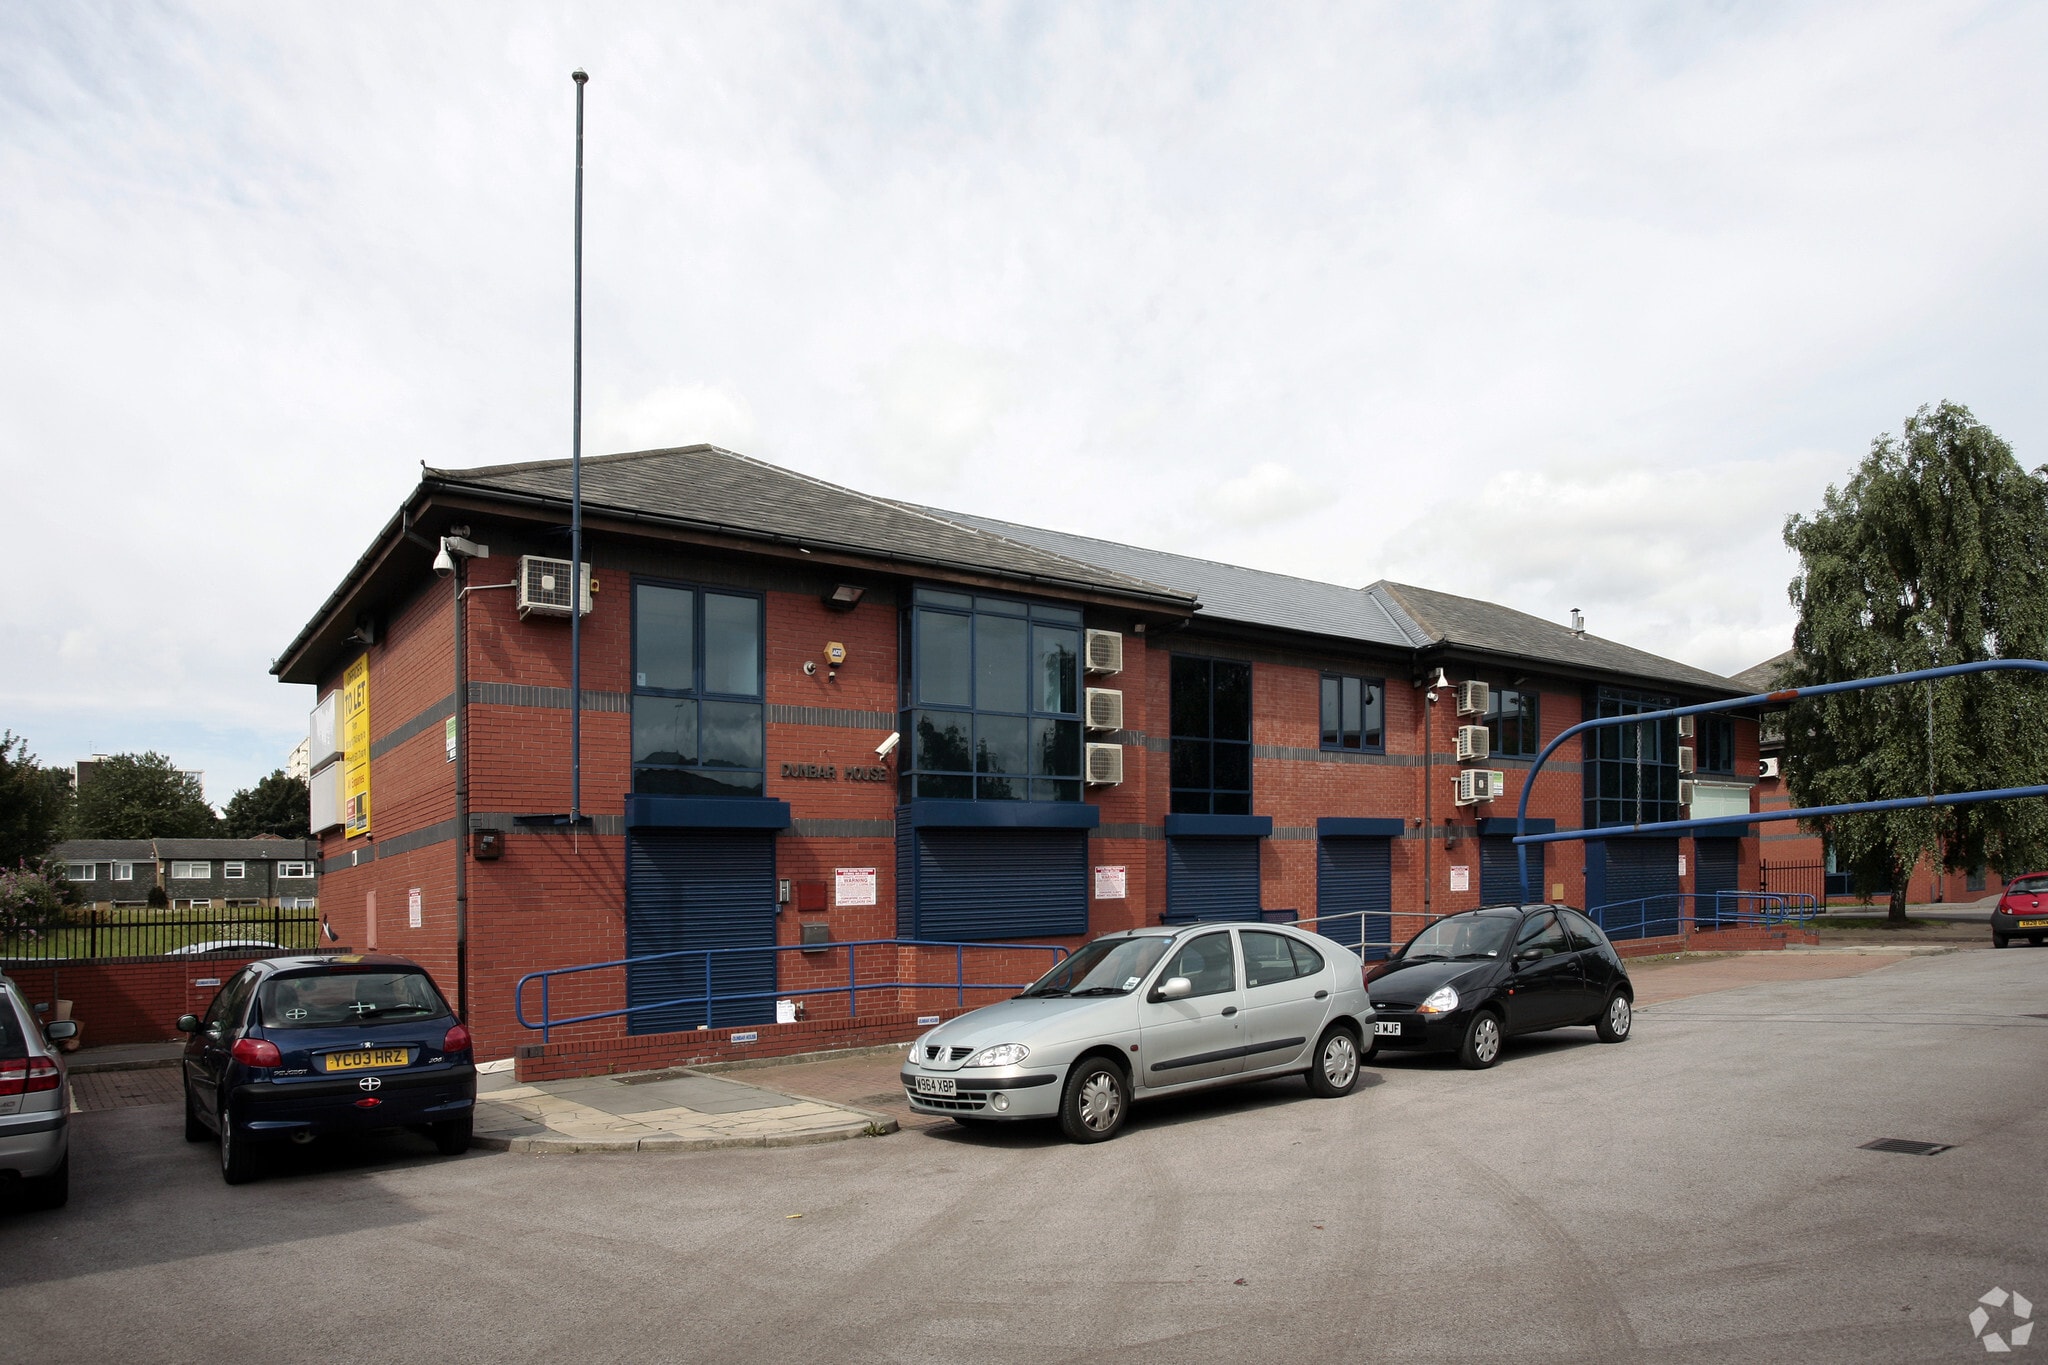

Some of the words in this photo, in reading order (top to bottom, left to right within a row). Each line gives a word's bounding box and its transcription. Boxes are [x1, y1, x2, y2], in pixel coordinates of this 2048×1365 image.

[345, 692, 352, 717] TO
[354, 680, 366, 711] LET
[781, 763, 836, 779] DUNBAR
[844, 766, 887, 781] HOUSE
[1382, 1023, 1400, 1034] MJF
[333, 1053, 371, 1067] YC03
[375, 1050, 402, 1064] HRZ
[917, 1078, 936, 1091] W964
[937, 1080, 954, 1093] XBP
